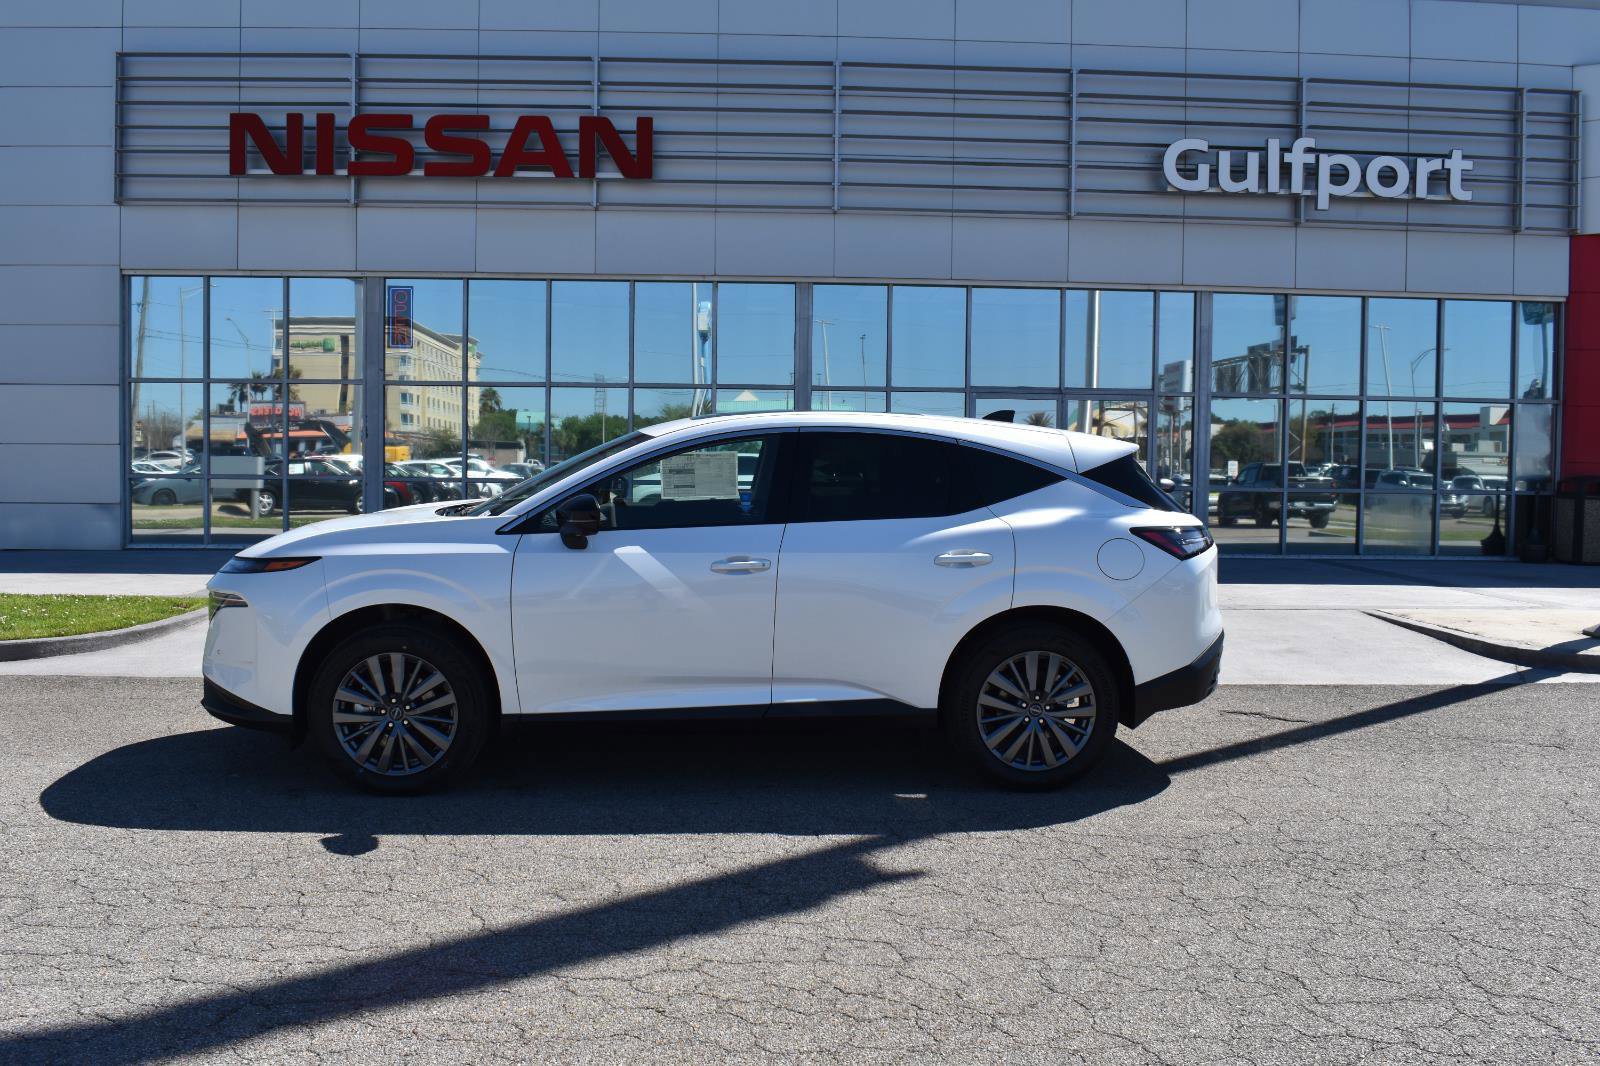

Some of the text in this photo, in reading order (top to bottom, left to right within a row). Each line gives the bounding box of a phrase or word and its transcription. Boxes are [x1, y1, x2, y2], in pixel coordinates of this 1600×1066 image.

[229, 112, 654, 179] NISSAN
[1162, 137, 1474, 210] Gulfport
[394, 290, 408, 345] OPEN
